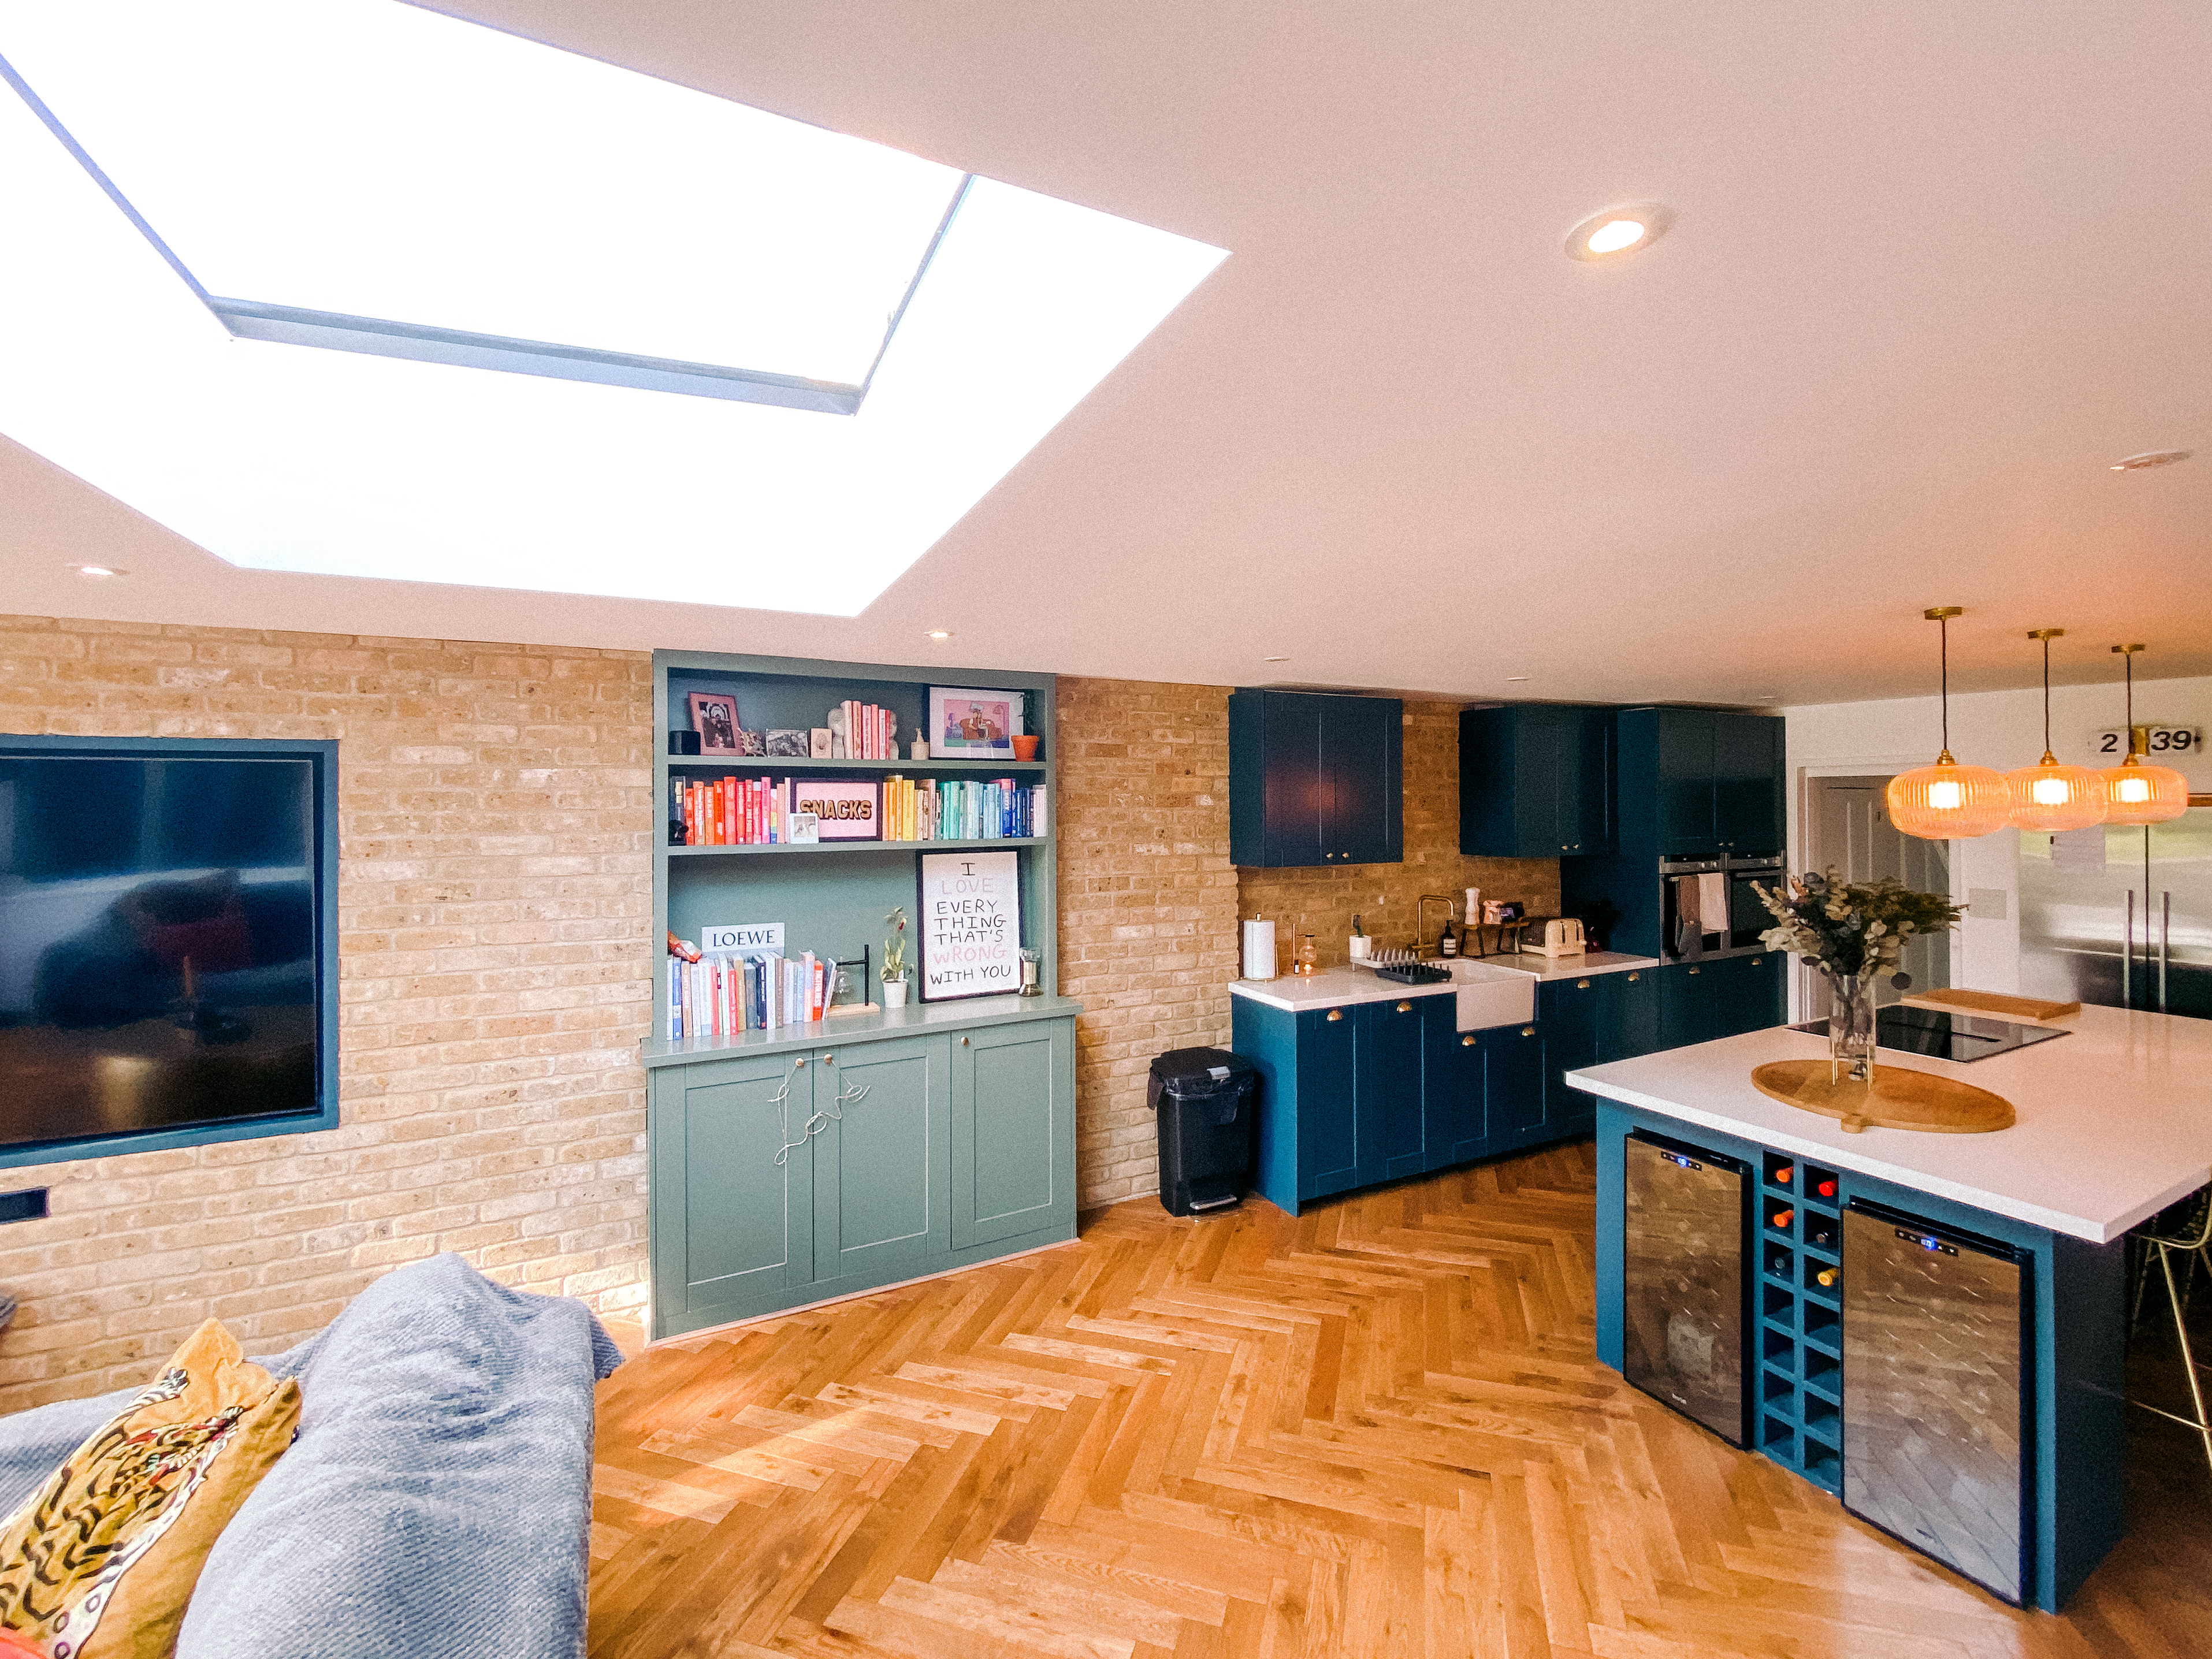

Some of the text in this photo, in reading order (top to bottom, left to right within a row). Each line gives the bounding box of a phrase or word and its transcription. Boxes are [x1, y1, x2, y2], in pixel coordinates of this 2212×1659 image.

[2101, 730, 2192, 753] 2 39
[800, 799, 872, 820] SNACKS
[961, 862, 976, 876] I
[942, 877, 994, 895] LOVE
[937, 899, 998, 914] EVERY
[934, 914, 1007, 931] THING
[713, 929, 775, 947] LOEWE
[934, 929, 1003, 946] THAT'S
[933, 943, 1008, 964] WRONG
[930, 965, 1012, 985] WITH YOU
